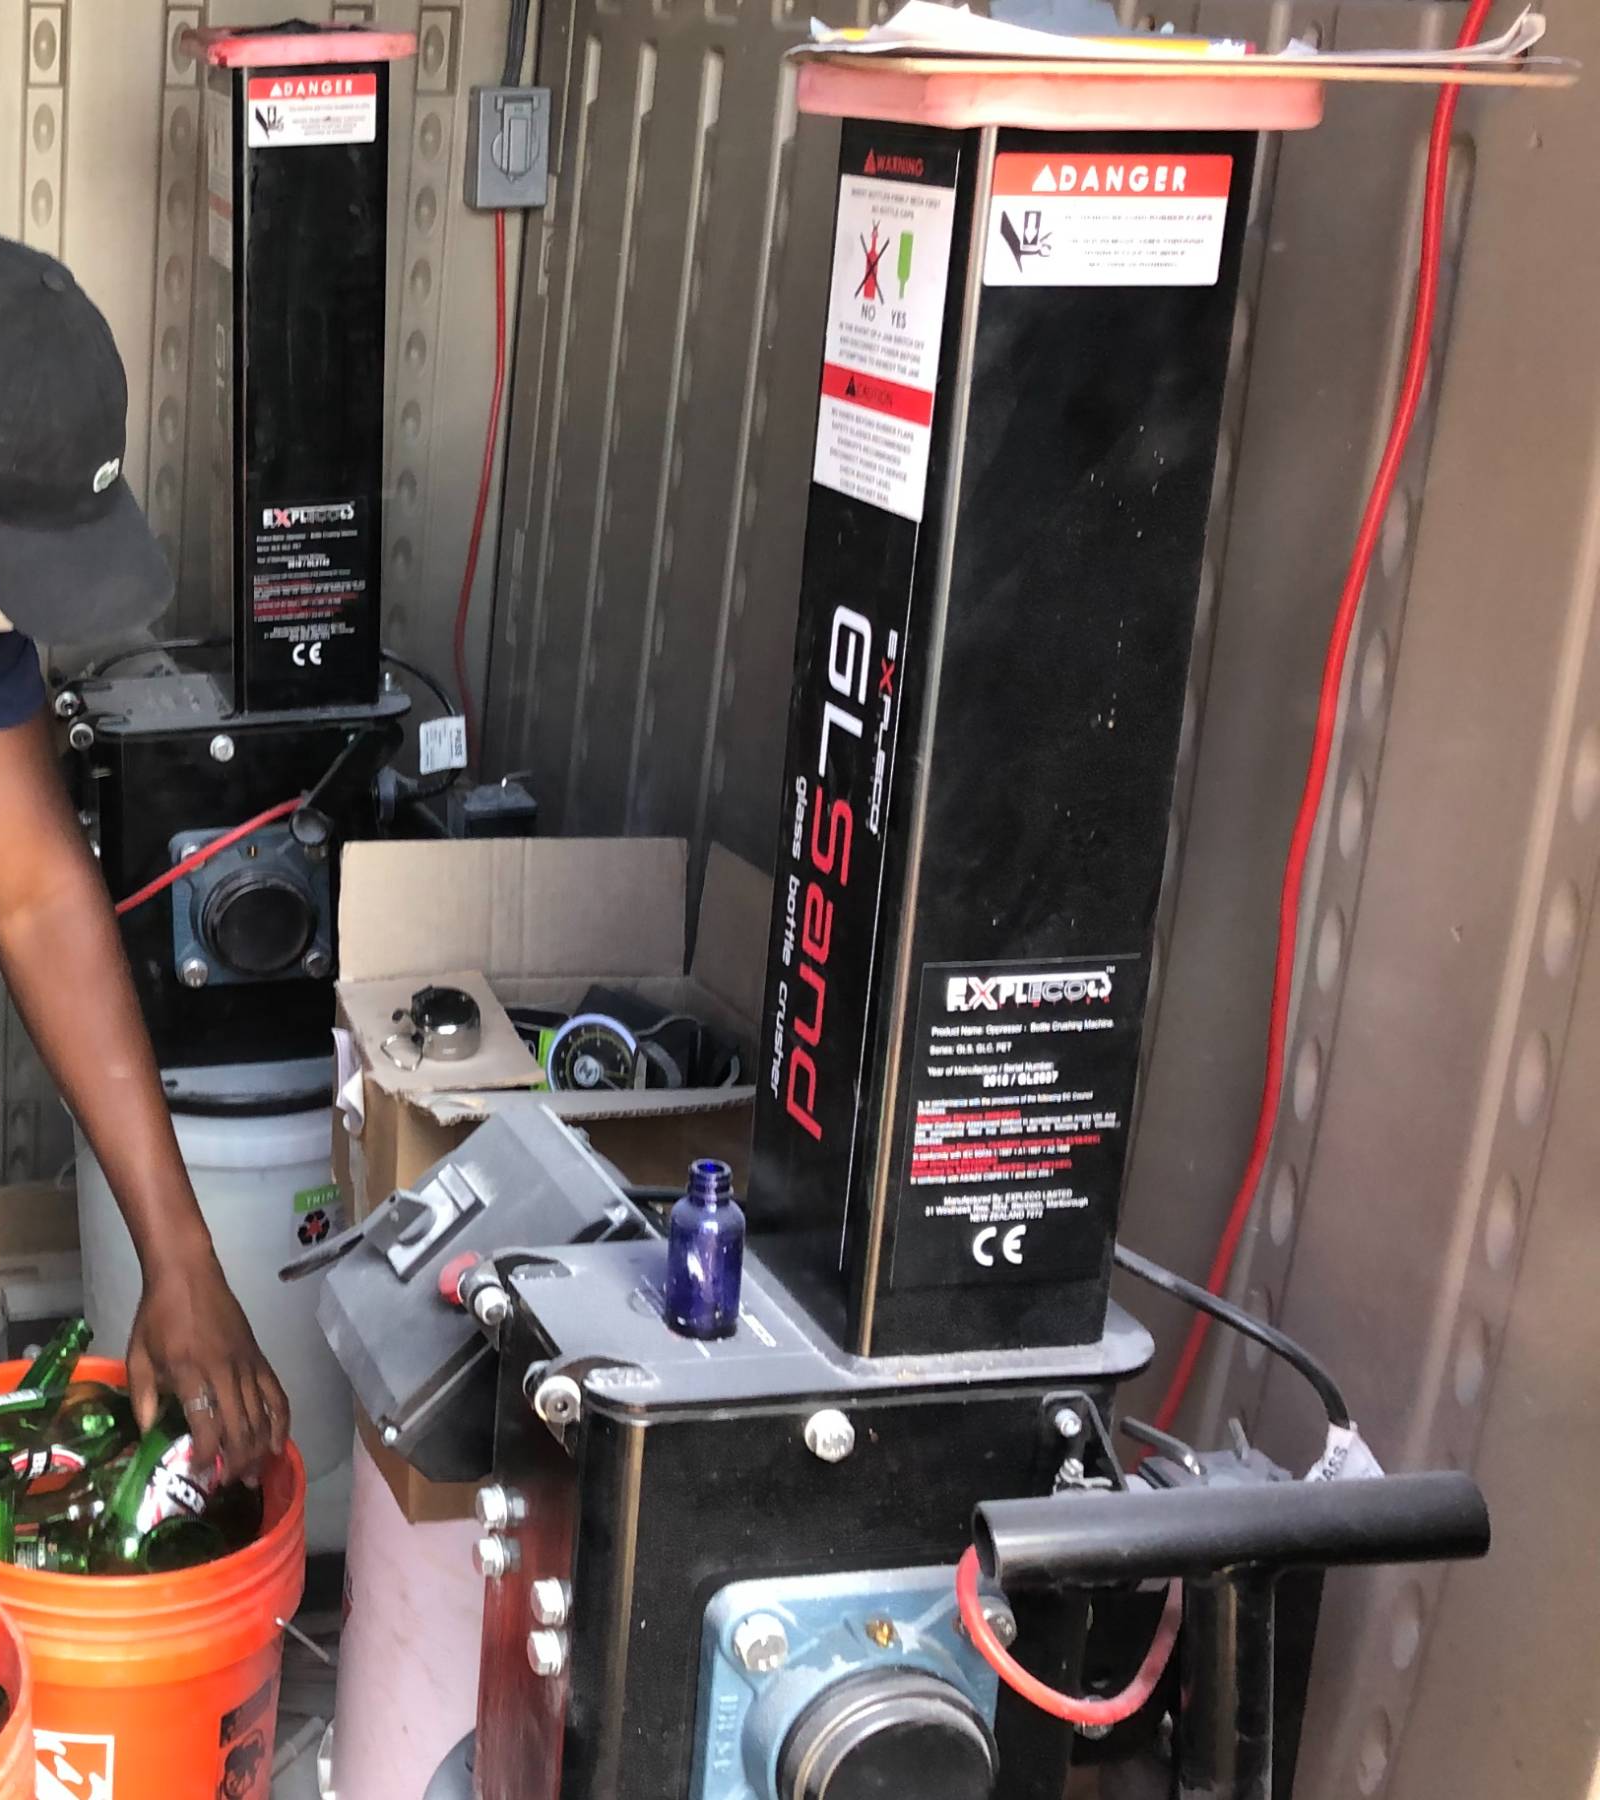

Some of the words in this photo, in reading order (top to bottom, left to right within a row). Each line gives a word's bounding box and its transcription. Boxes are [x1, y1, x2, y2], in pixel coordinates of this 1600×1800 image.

[284, 80, 353, 96] DANGER
[876, 155, 925, 177] WARNING
[1058, 165, 1188, 193] DANGER
[861, 304, 876, 322] NO
[891, 309, 907, 329] YES
[897, 427, 914, 442] FLAPS
[293, 641, 322, 666] CE
[791, 775, 807, 860] glass
[781, 873, 801, 968] bottle
[770, 980, 788, 1100] crusher
[931, 1025, 959, 1037] Product
[1030, 1022, 1050, 1034] Bottle
[1052, 1020, 1083, 1032] Crushing
[1084, 1018, 1114, 1030] Machine
[927, 1065, 944, 1077] Year
[945, 1065, 953, 1076] of
[954, 1063, 998, 1076] Manufacture
[972, 1223, 1027, 1268] CE
